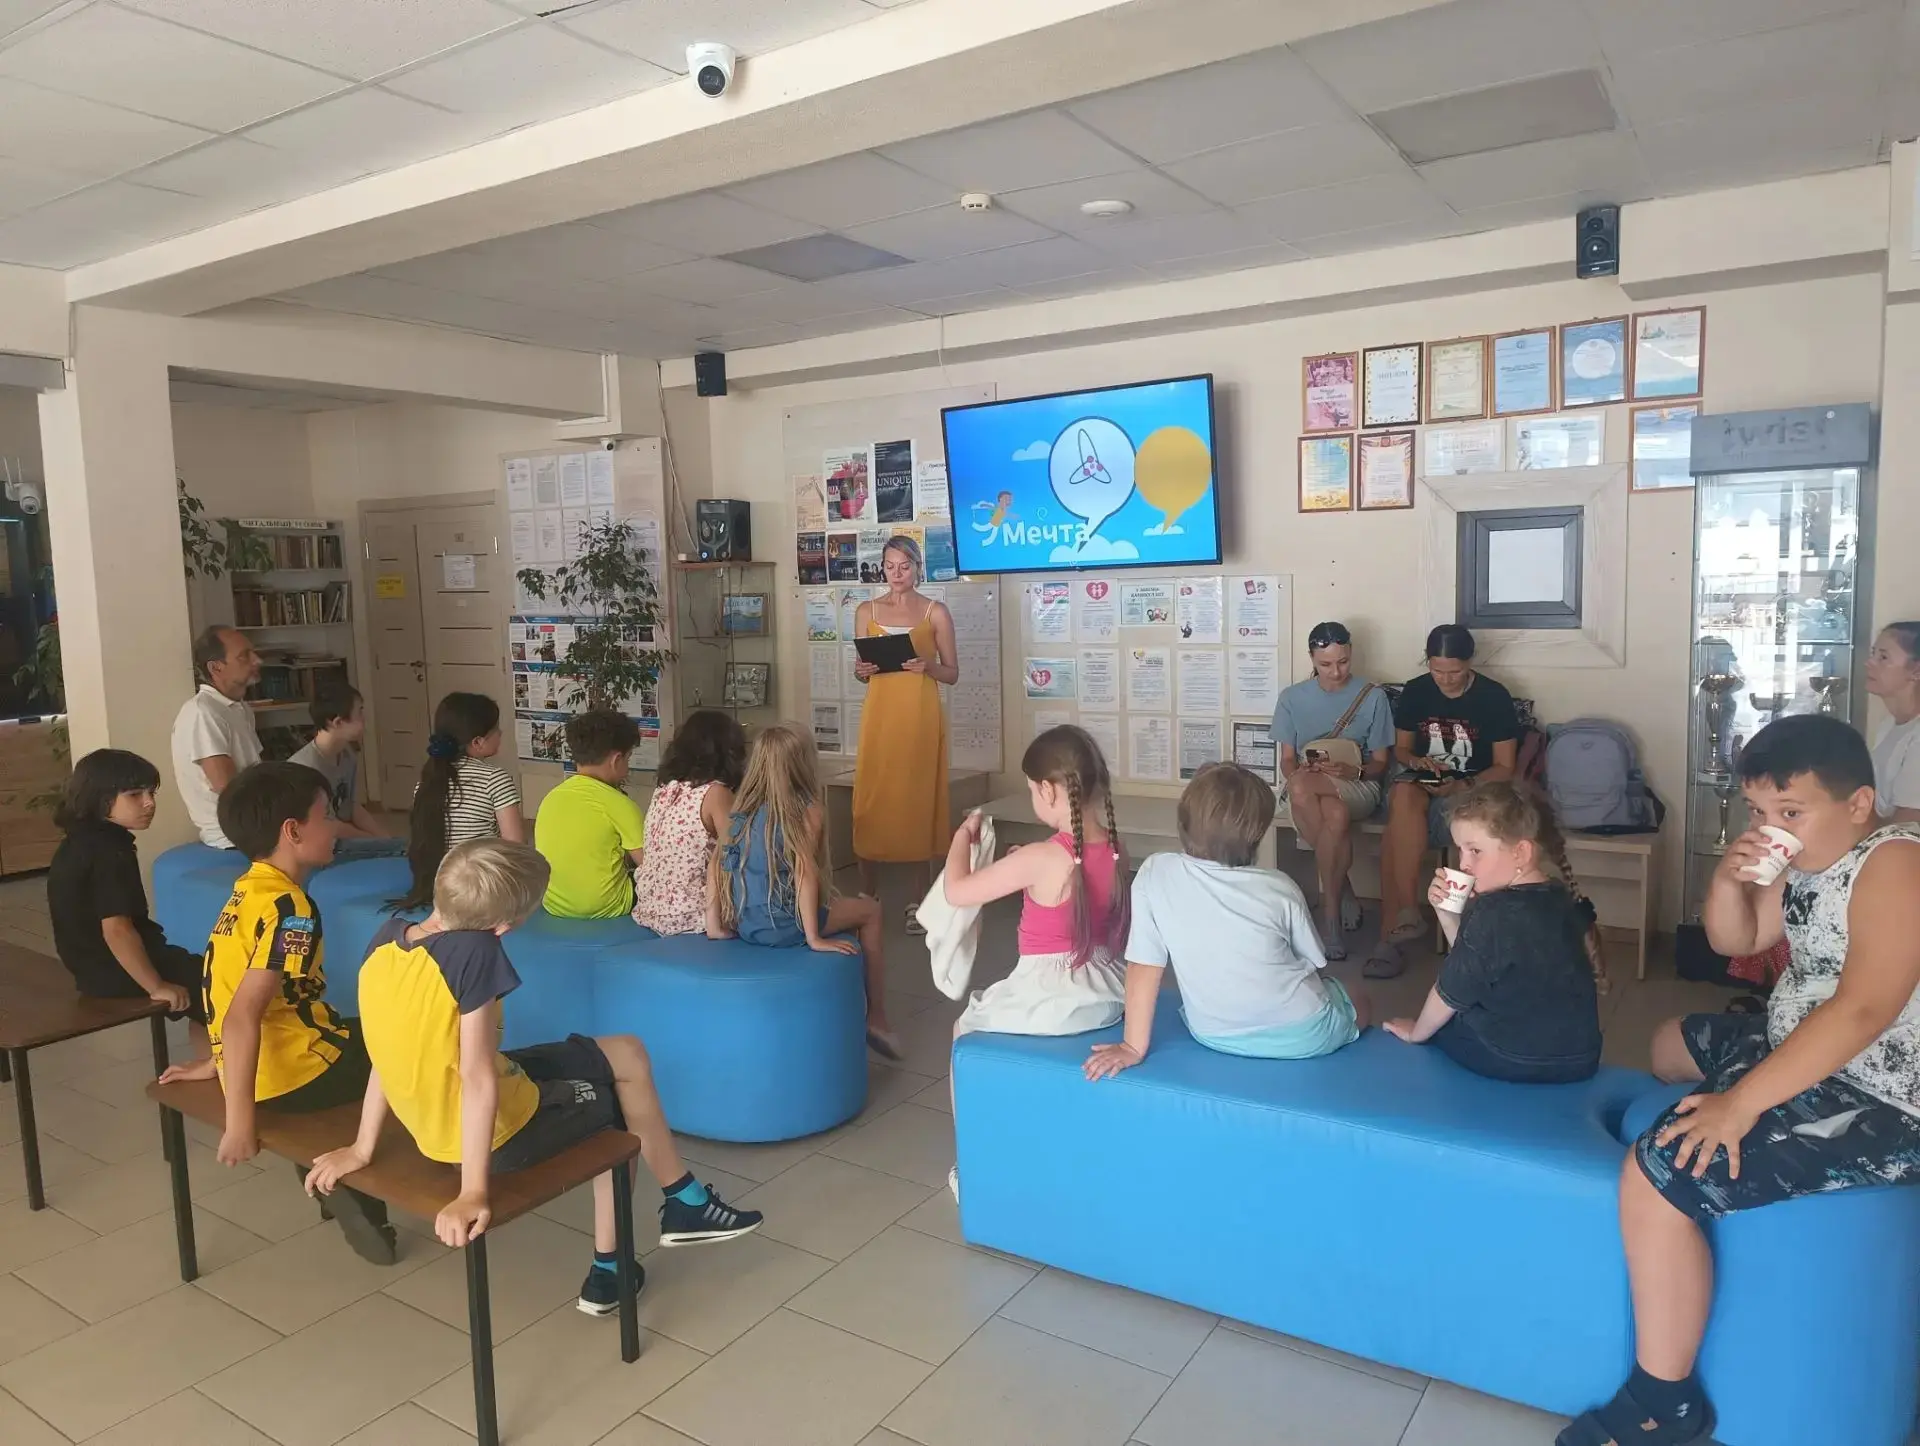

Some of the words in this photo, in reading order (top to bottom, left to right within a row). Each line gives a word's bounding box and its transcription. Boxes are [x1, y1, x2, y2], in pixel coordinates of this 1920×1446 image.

[876, 475, 912, 487] UNIQUE
[1002, 520, 1090, 547] Мечта
[282, 943, 310, 956] YELO
